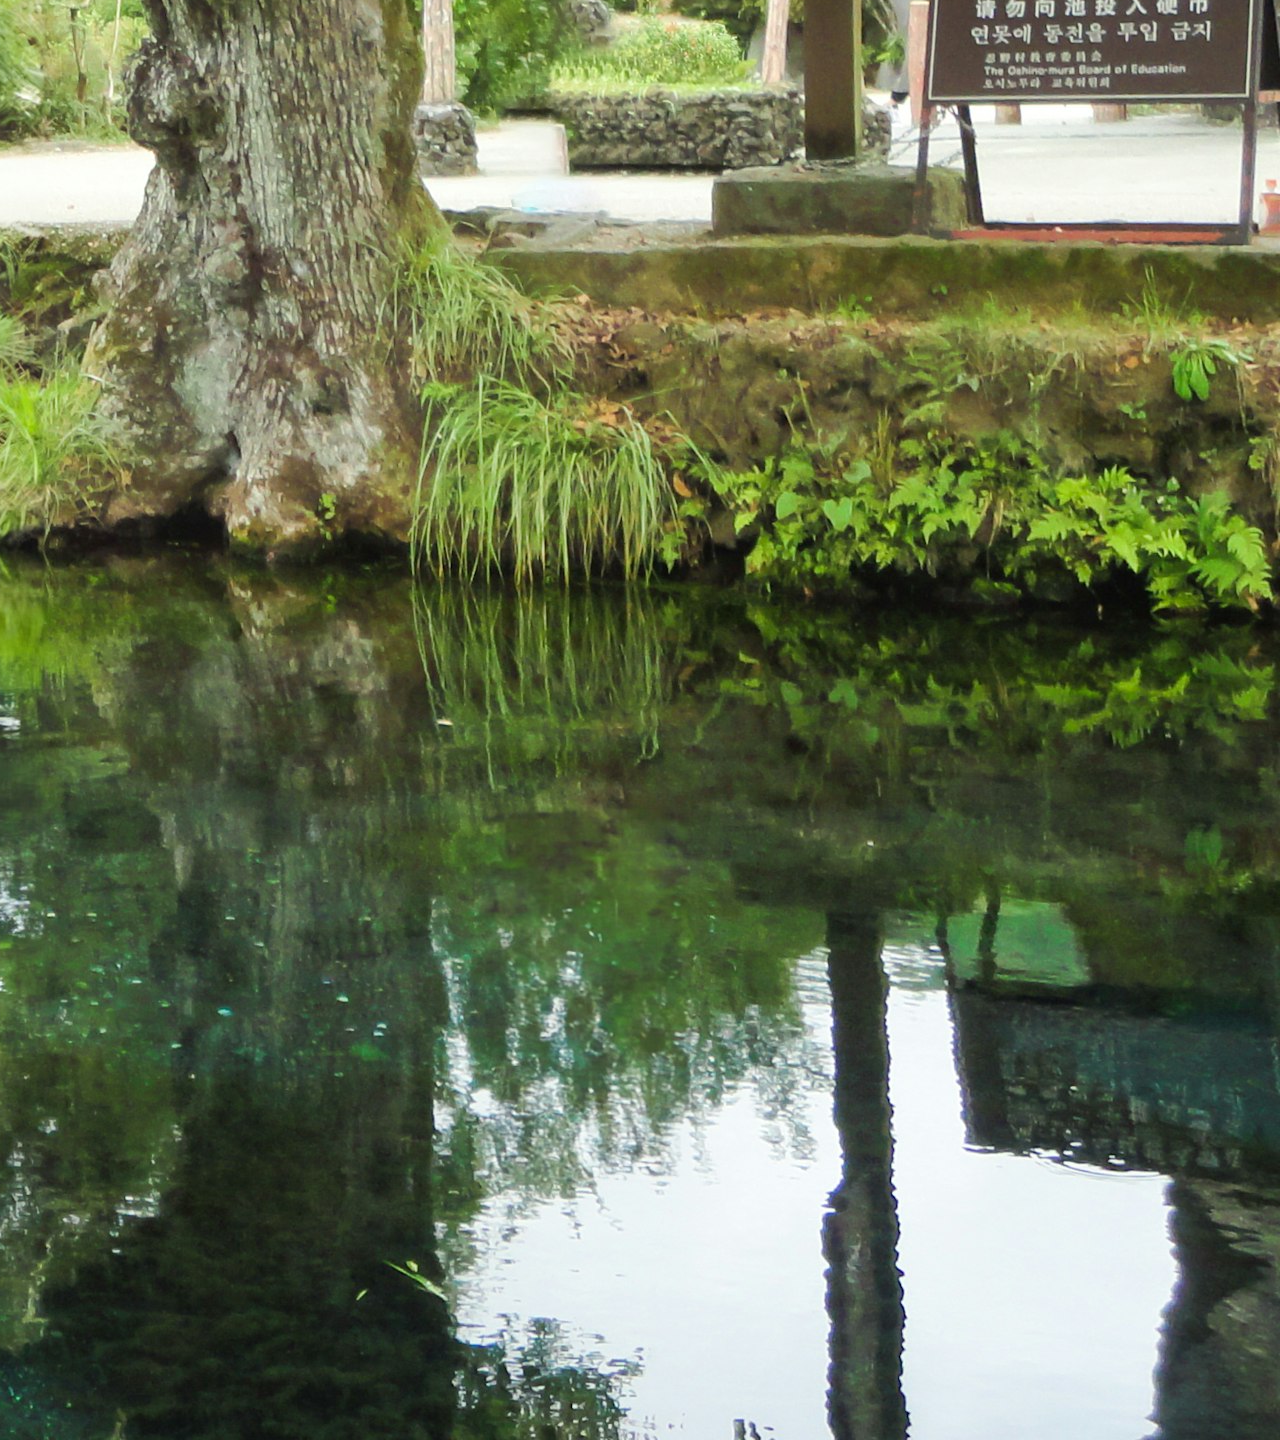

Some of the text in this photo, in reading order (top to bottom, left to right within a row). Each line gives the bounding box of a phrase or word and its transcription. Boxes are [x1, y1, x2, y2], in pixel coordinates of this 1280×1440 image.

[970, 20, 1211, 45] 연못에 동전을 투입 금지
[984, 63, 1186, 77] The Oshino-mura Board of Education
